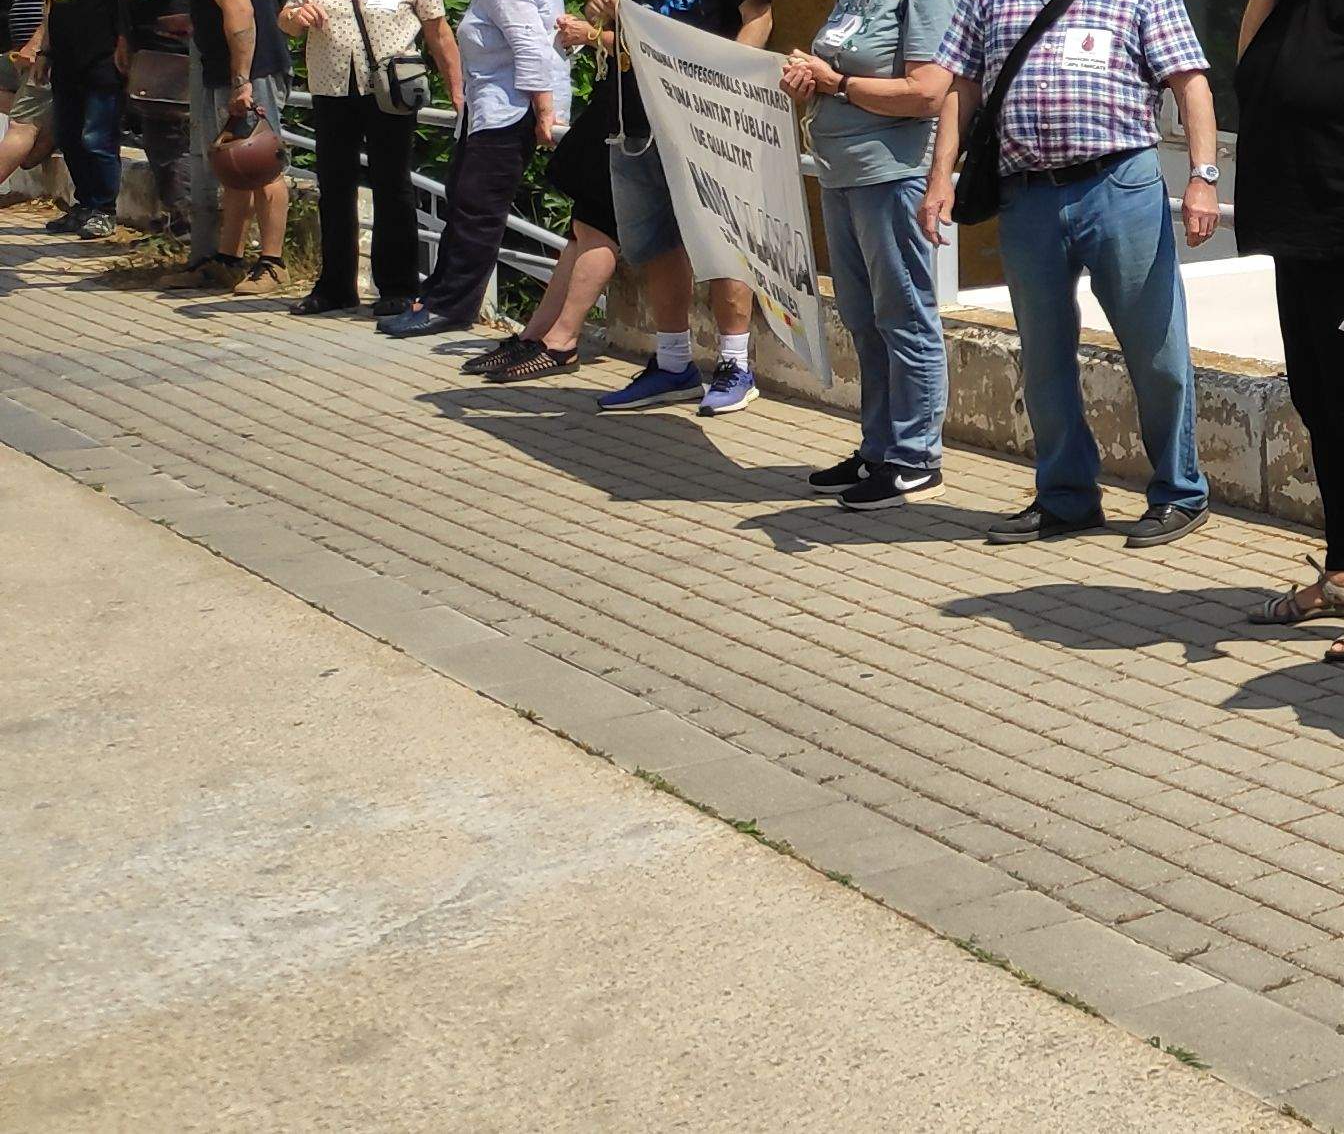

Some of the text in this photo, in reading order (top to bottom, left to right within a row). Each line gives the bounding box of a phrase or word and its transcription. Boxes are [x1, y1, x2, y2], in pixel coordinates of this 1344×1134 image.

[678, 59, 742, 96] PROFESSIONALS
[741, 81, 790, 113] SANITARIS
[692, 93, 732, 127] SANITAT
[734, 108, 781, 148] PÚBLICA
